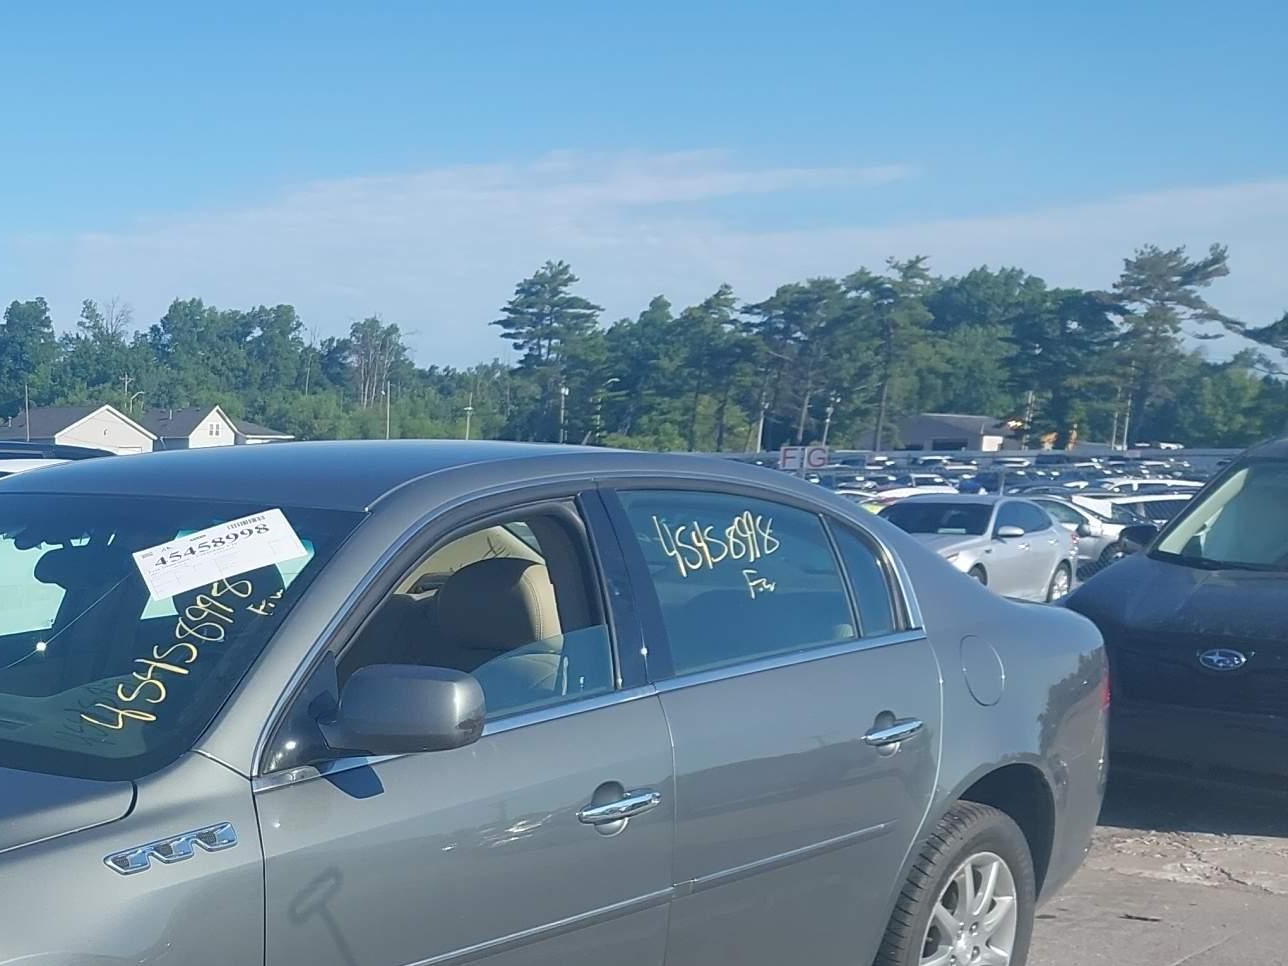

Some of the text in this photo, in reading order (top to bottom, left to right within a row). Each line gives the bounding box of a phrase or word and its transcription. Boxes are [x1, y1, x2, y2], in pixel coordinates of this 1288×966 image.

[783, 447, 799, 468] F
[807, 447, 826, 468] G
[155, 523, 270, 567] 45458998
[652, 510, 779, 577] 45458998
